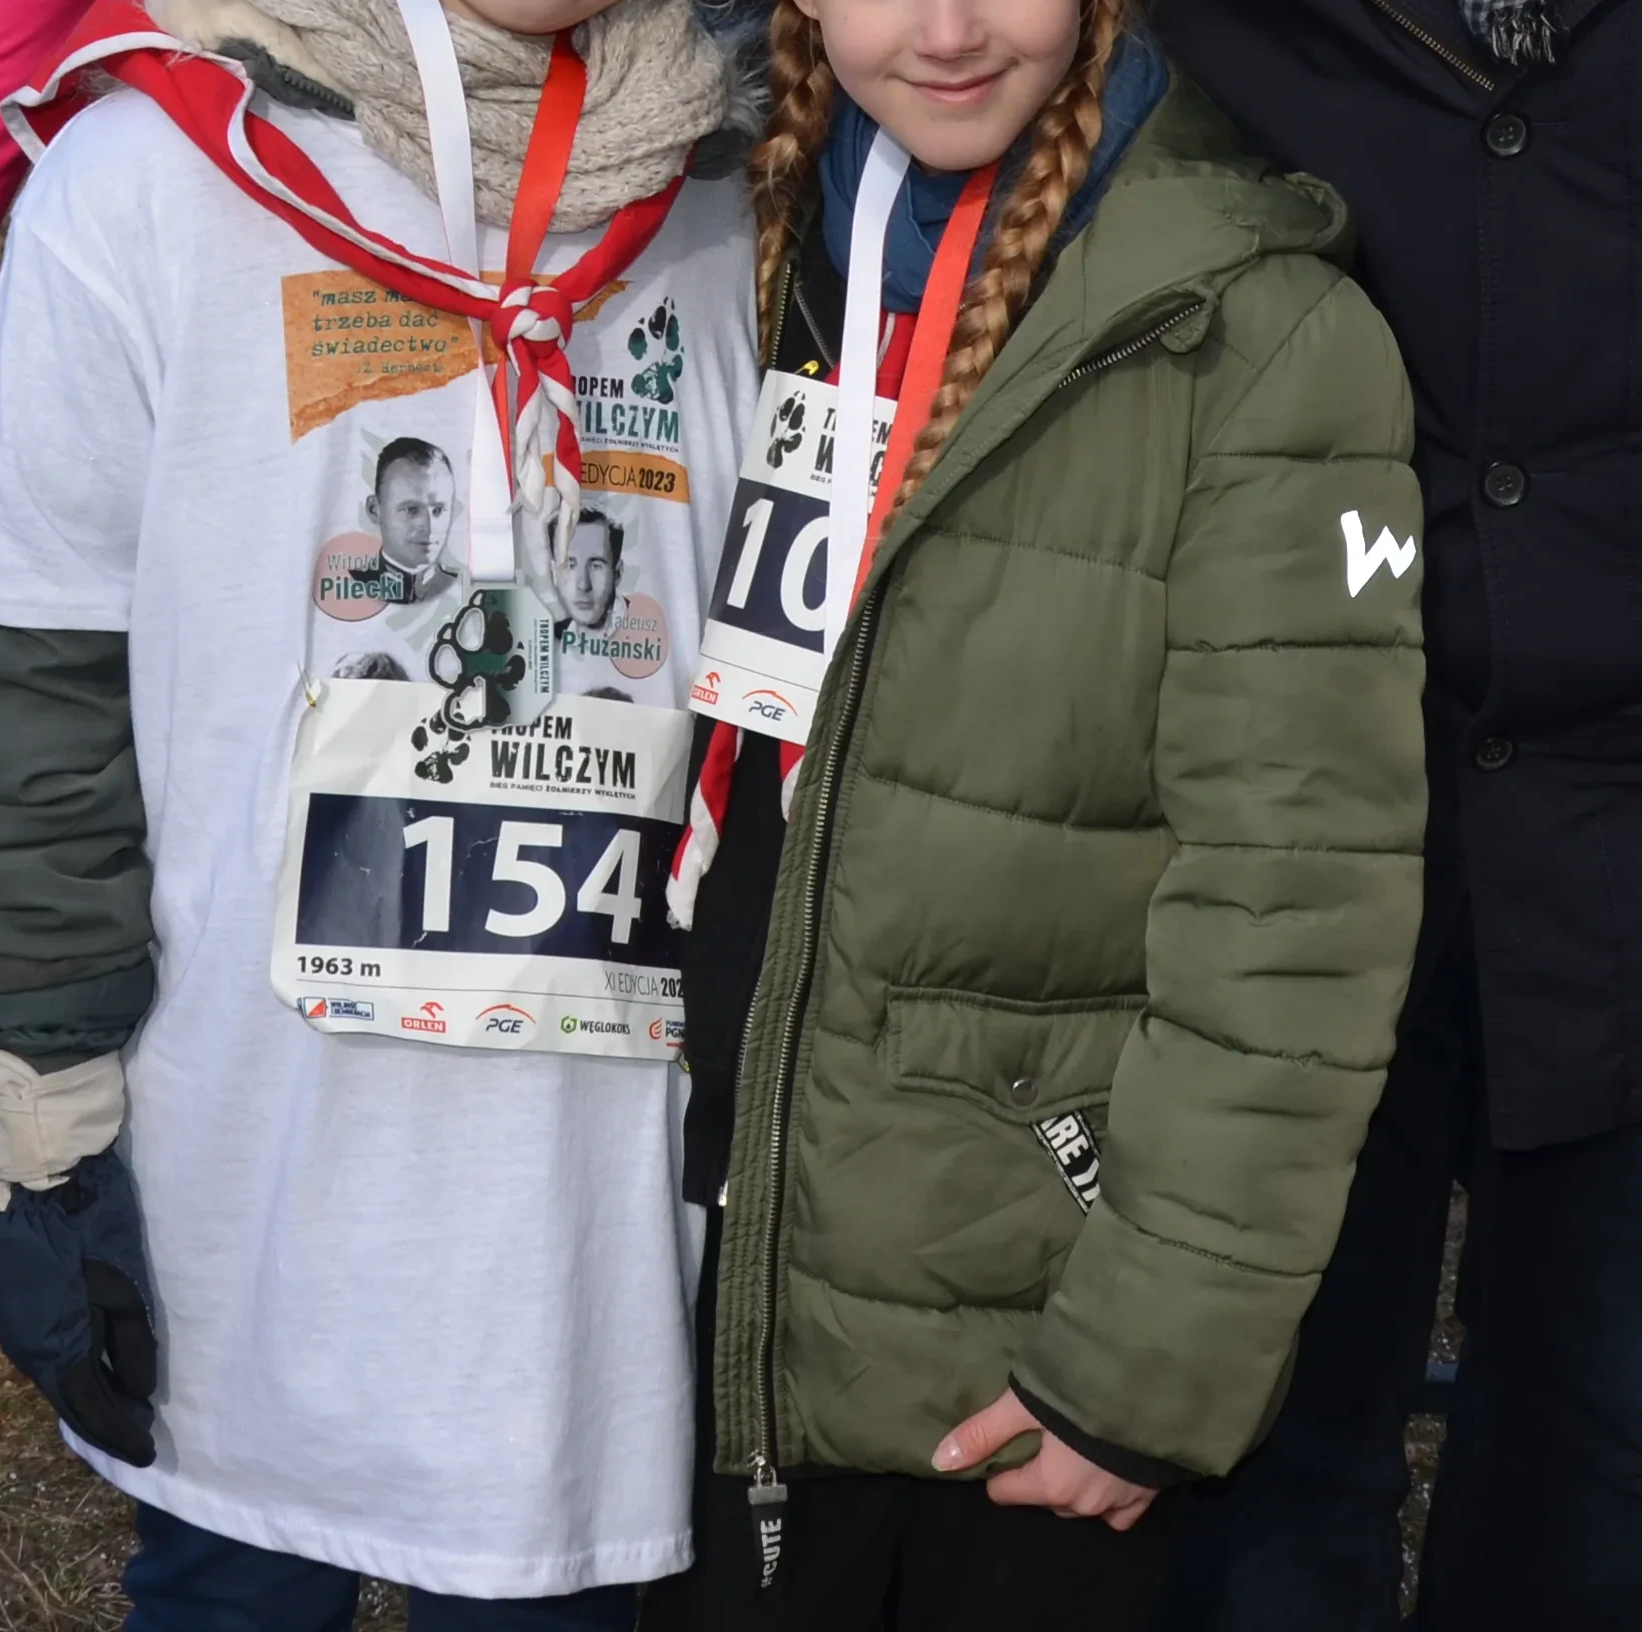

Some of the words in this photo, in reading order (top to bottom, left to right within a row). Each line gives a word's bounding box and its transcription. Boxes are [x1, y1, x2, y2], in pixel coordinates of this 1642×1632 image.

[312, 310, 392, 332] trzeba
[399, 310, 440, 328] dać
[638, 468, 676, 494] 2023
[327, 552, 380, 572] Witold
[319, 574, 404, 601] Pilecki
[562, 630, 662, 661] Płużański
[749, 700, 786, 722] PGE
[490, 739, 636, 789] WILCZYM
[402, 815, 642, 945] 154
[297, 956, 353, 976] 1963
[360, 962, 381, 977] m
[604, 971, 616, 991] XI
[619, 972, 659, 997] EDYCJA
[660, 976, 684, 998] 202
[402, 1018, 445, 1033] ORLEN
[485, 1017, 524, 1034] PGE
